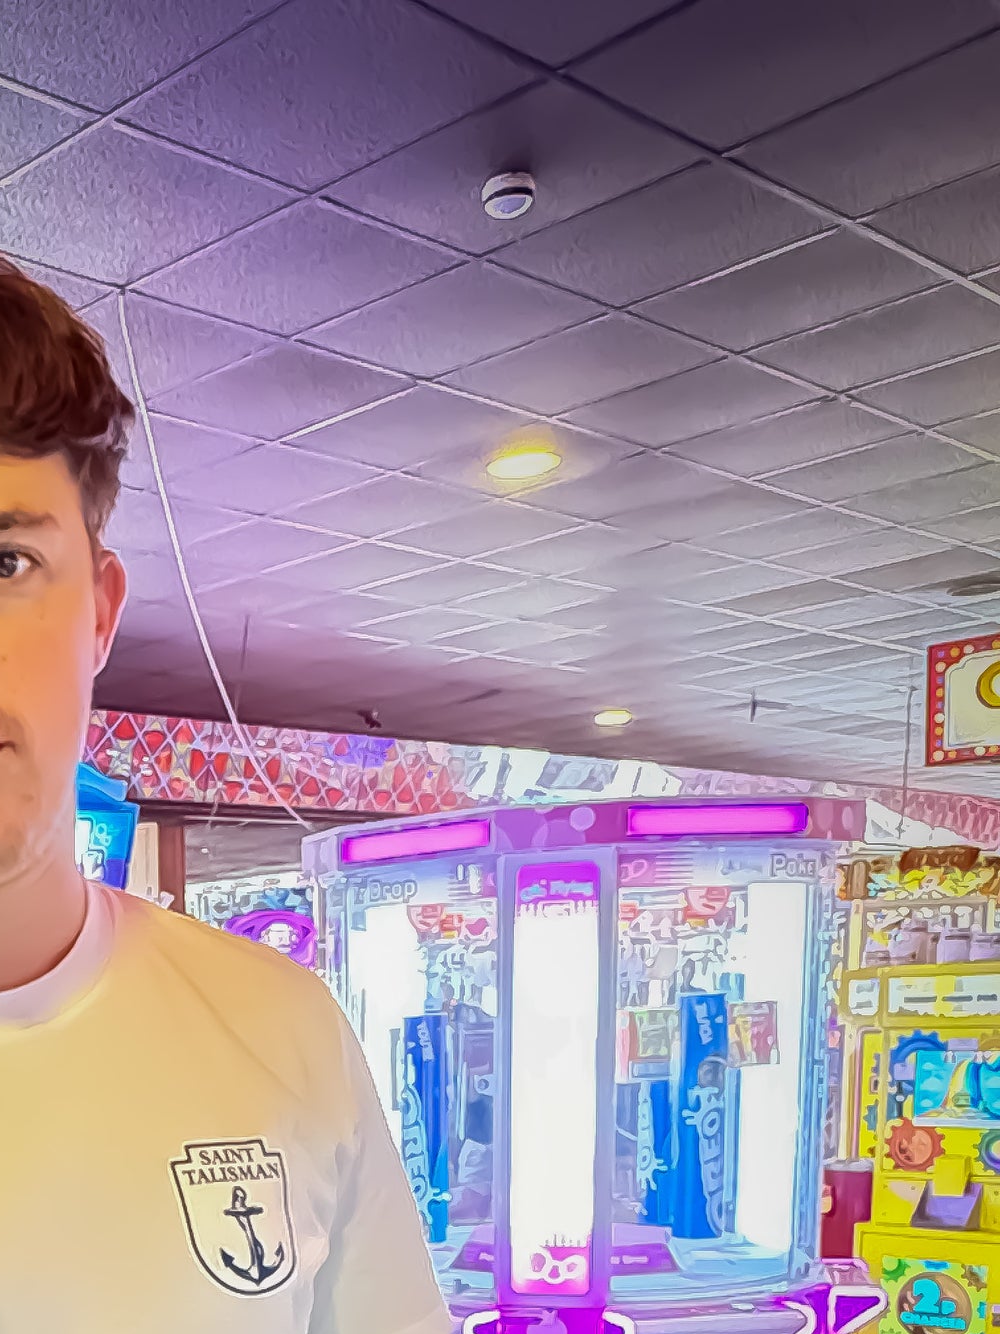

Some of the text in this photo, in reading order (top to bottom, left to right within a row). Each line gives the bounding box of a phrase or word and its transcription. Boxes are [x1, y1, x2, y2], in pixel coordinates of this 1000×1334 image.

[370, 879, 418, 903] Drop
[200, 1148, 254, 1165] SAINT
[182, 1162, 280, 1185] TALISMAN
